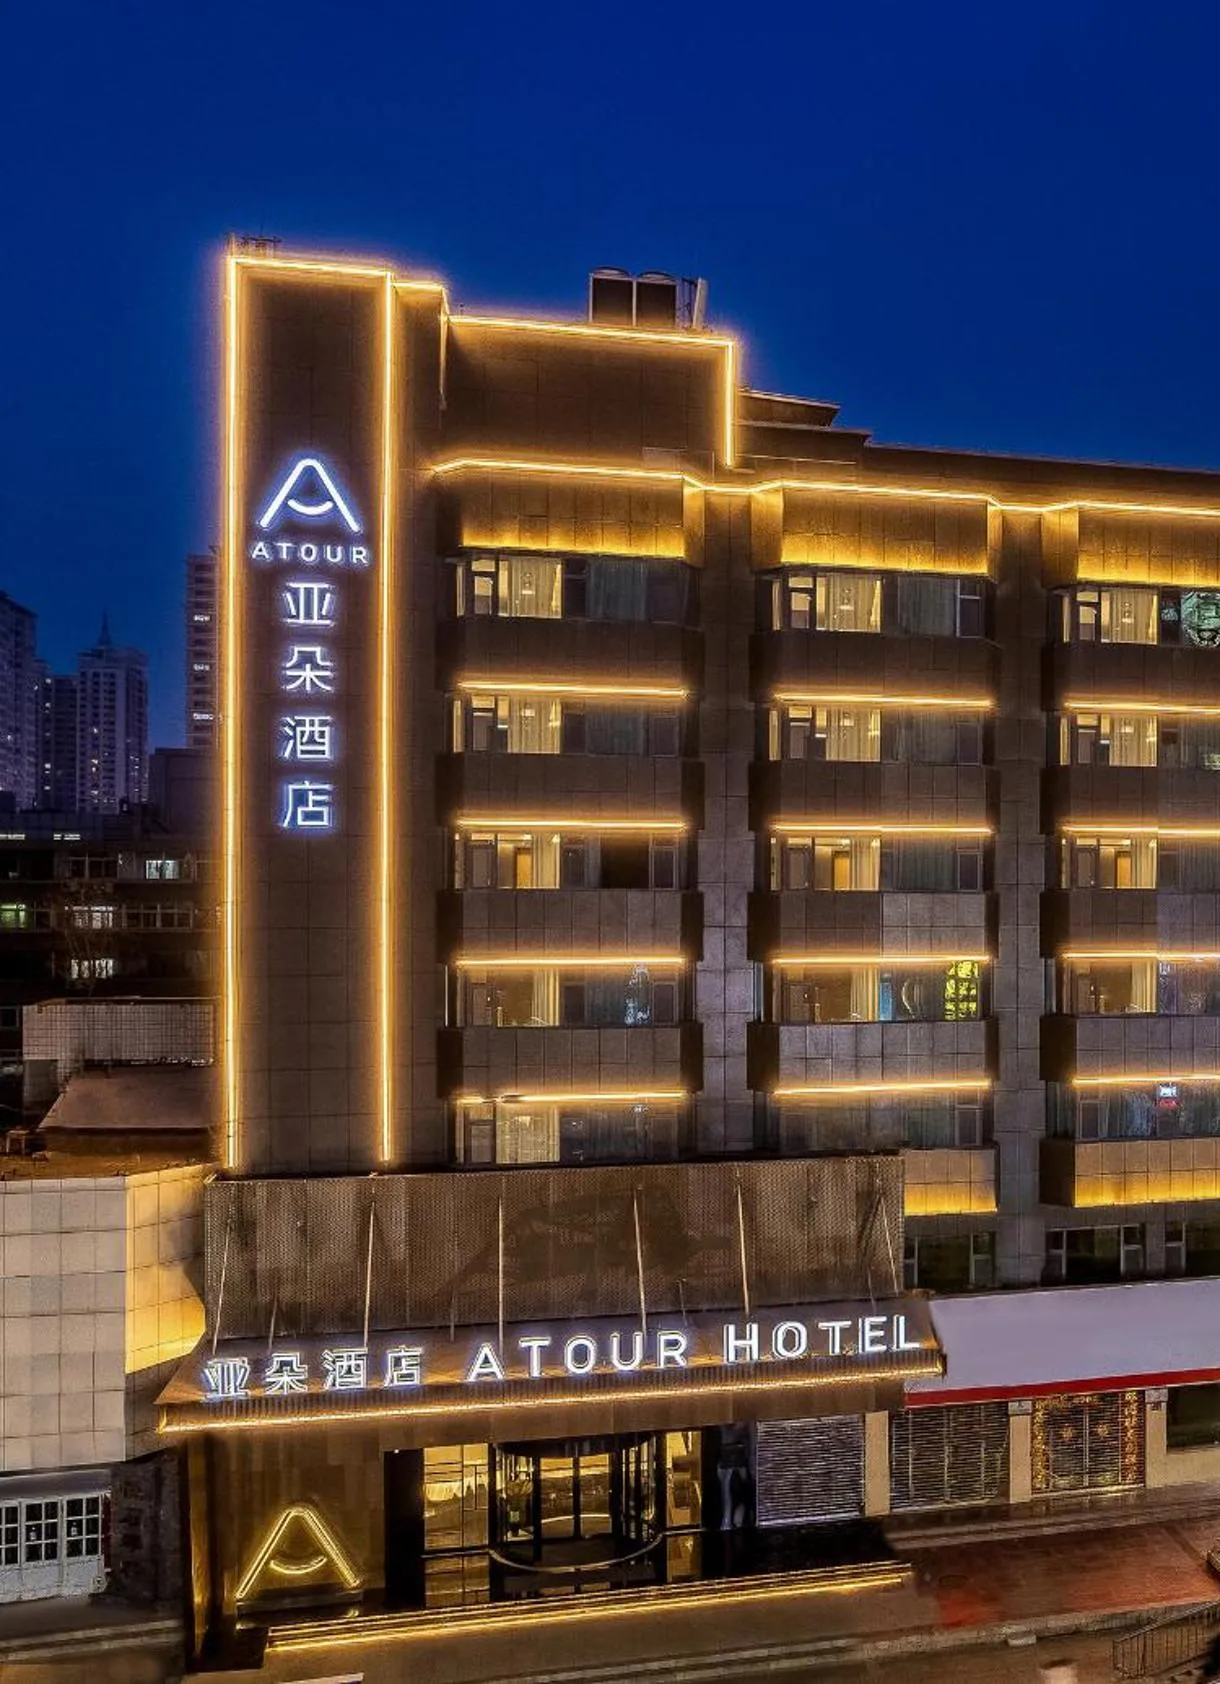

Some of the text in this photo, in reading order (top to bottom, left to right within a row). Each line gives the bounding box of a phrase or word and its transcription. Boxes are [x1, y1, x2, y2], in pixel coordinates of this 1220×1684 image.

[251, 541, 369, 564] ATOUR
[281, 580, 337, 830] 亚朵酒店
[202, 1314, 921, 1401] 亚朵酒店 ATOUR HOTEL
